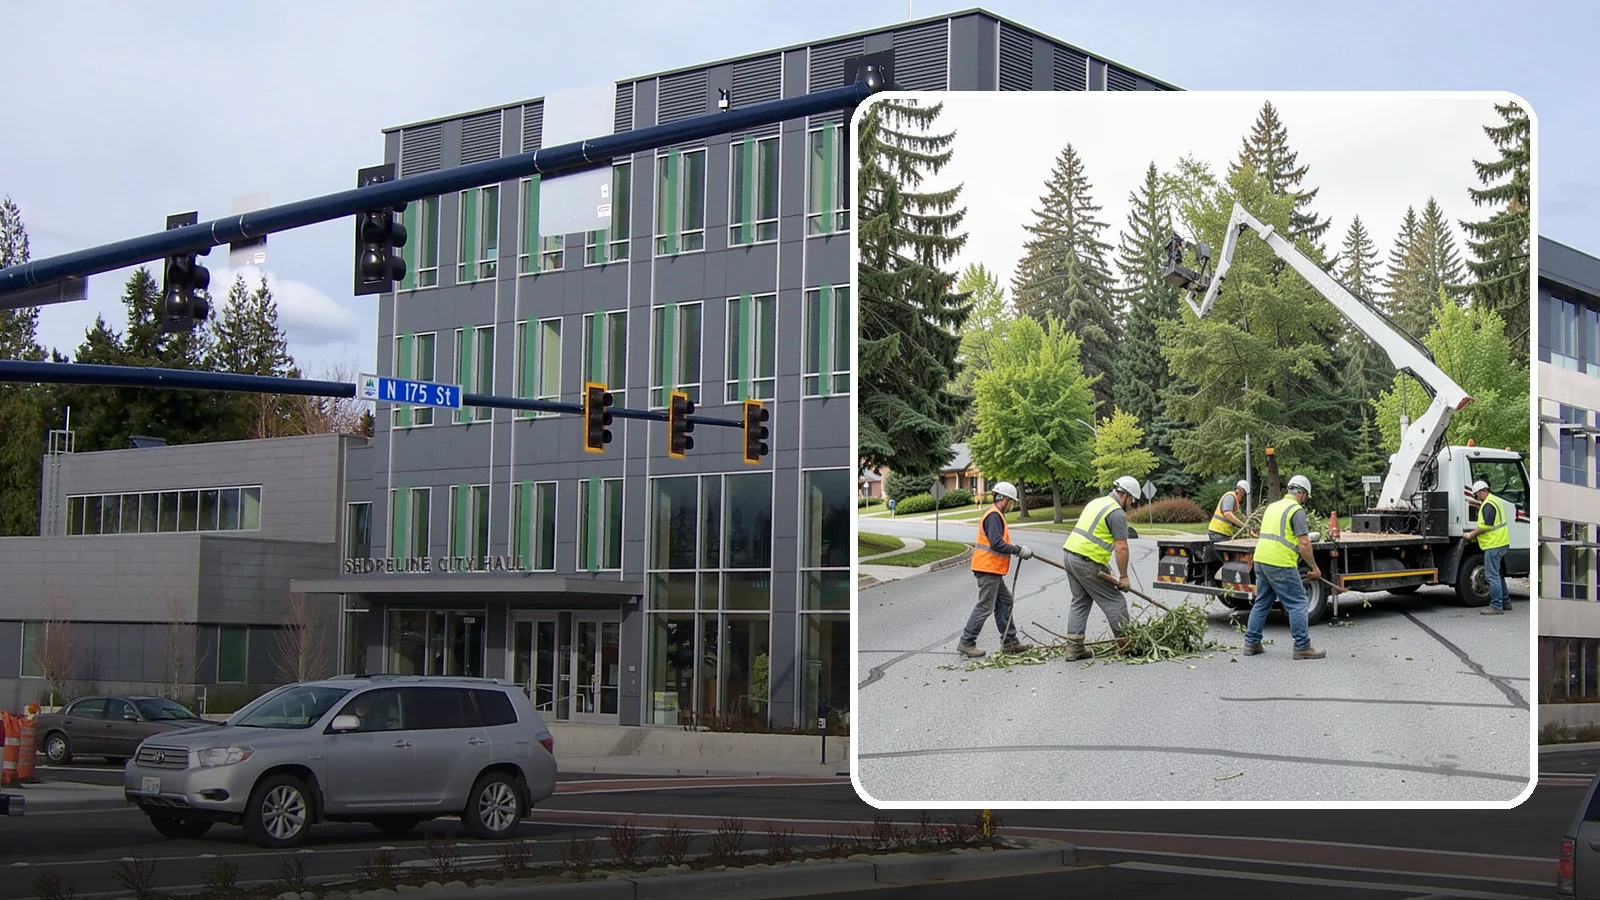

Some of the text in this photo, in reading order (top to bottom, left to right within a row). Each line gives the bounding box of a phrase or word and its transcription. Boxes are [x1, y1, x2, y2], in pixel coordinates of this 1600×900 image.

[387, 380, 451, 406] N 175 St
[343, 555, 525, 574] SHORELINE CITY HALL
